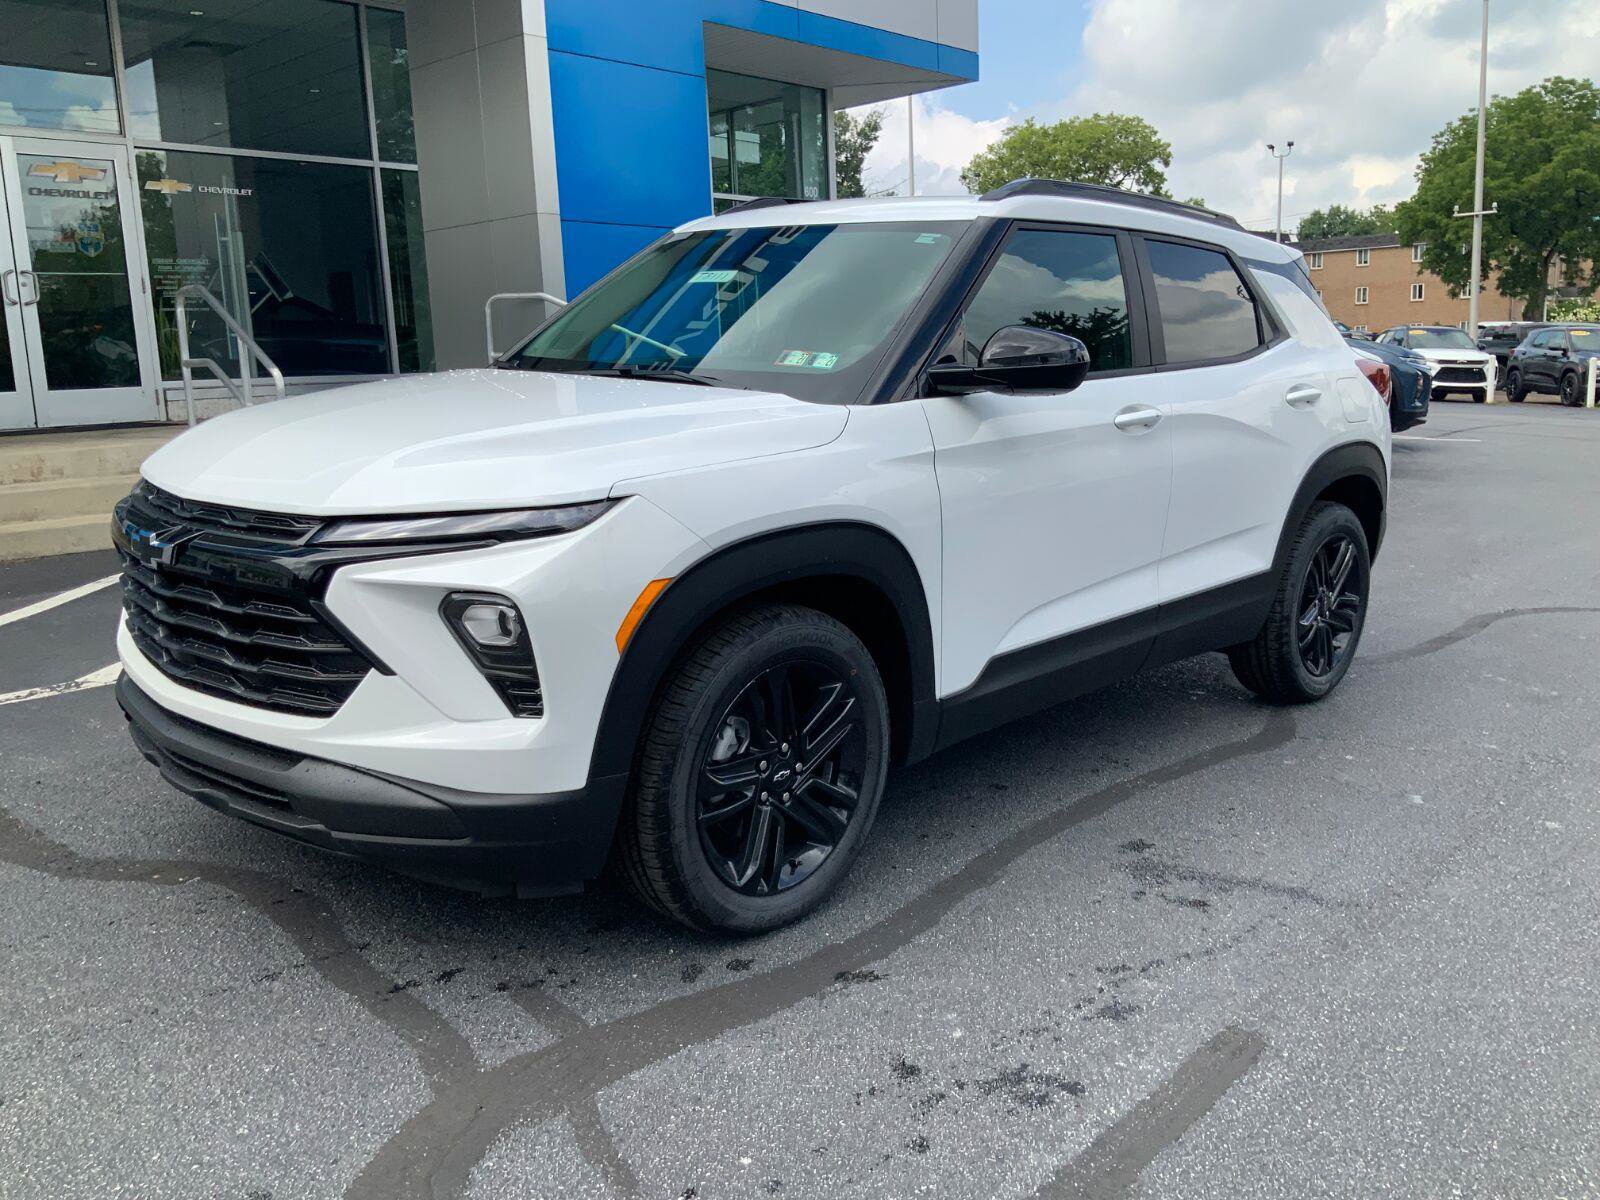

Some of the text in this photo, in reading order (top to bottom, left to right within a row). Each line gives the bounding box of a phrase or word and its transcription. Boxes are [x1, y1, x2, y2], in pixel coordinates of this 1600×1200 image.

[28, 187, 111, 201] CHEVROLET
[198, 185, 253, 196] CHEVROLET
[804, 186, 819, 199] 600
